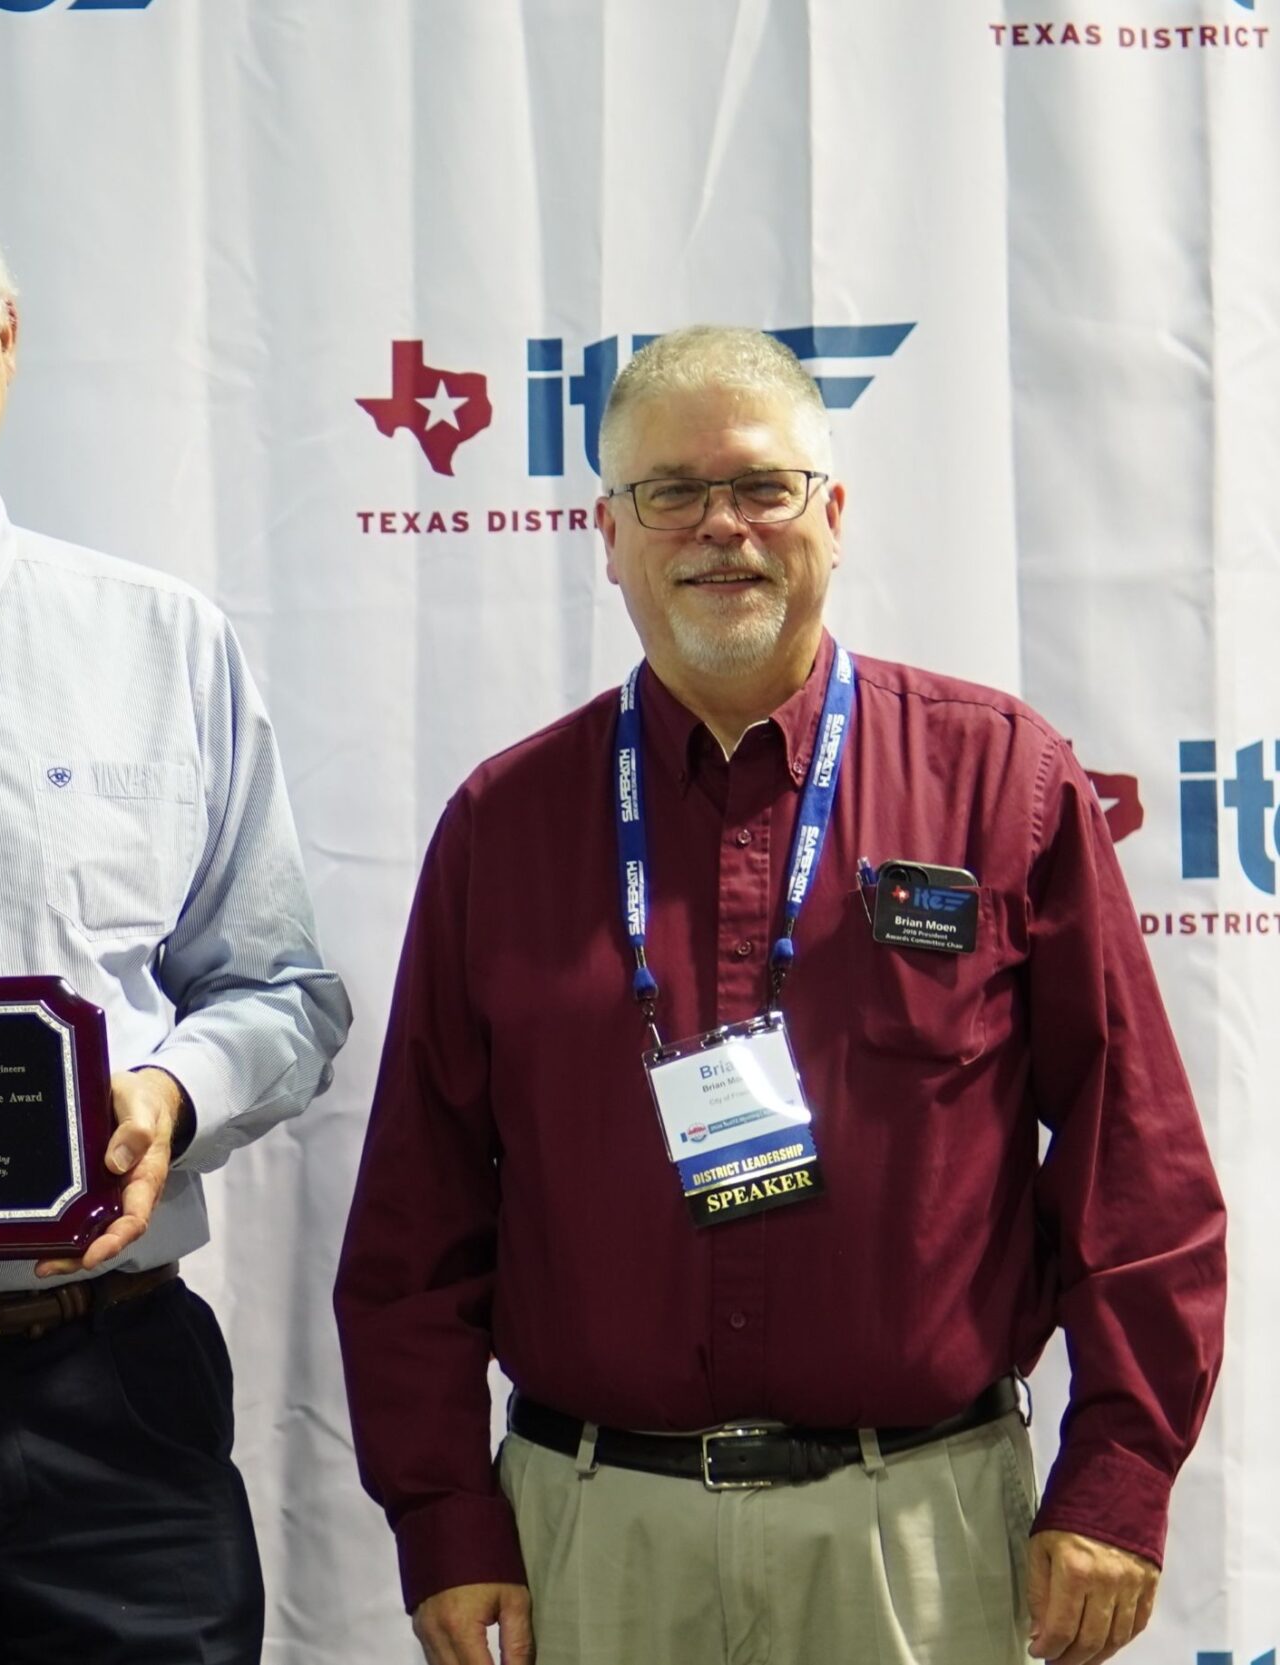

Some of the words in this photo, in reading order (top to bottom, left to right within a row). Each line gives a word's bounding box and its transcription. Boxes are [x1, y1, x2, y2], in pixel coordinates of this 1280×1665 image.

[989, 23, 1102, 46] TEXAS
[1118, 25, 1268, 49] DISTRICT
[356, 511, 469, 534] TEXAS
[488, 509, 598, 532] DISTR
[1179, 739, 1280, 896] it
[894, 915, 923, 928] Brian
[925, 920, 957, 933] Moen
[885, 933, 909, 942] Awards
[911, 937, 946, 948] Committee
[918, 930, 948, 941] President
[700, 1060, 735, 1079] Bria
[9, 1091, 43, 1103] Award
[692, 1162, 740, 1187] DISTRICT
[741, 1143, 804, 1172] LEADERSHIP
[706, 1170, 814, 1213] SPEAKER
